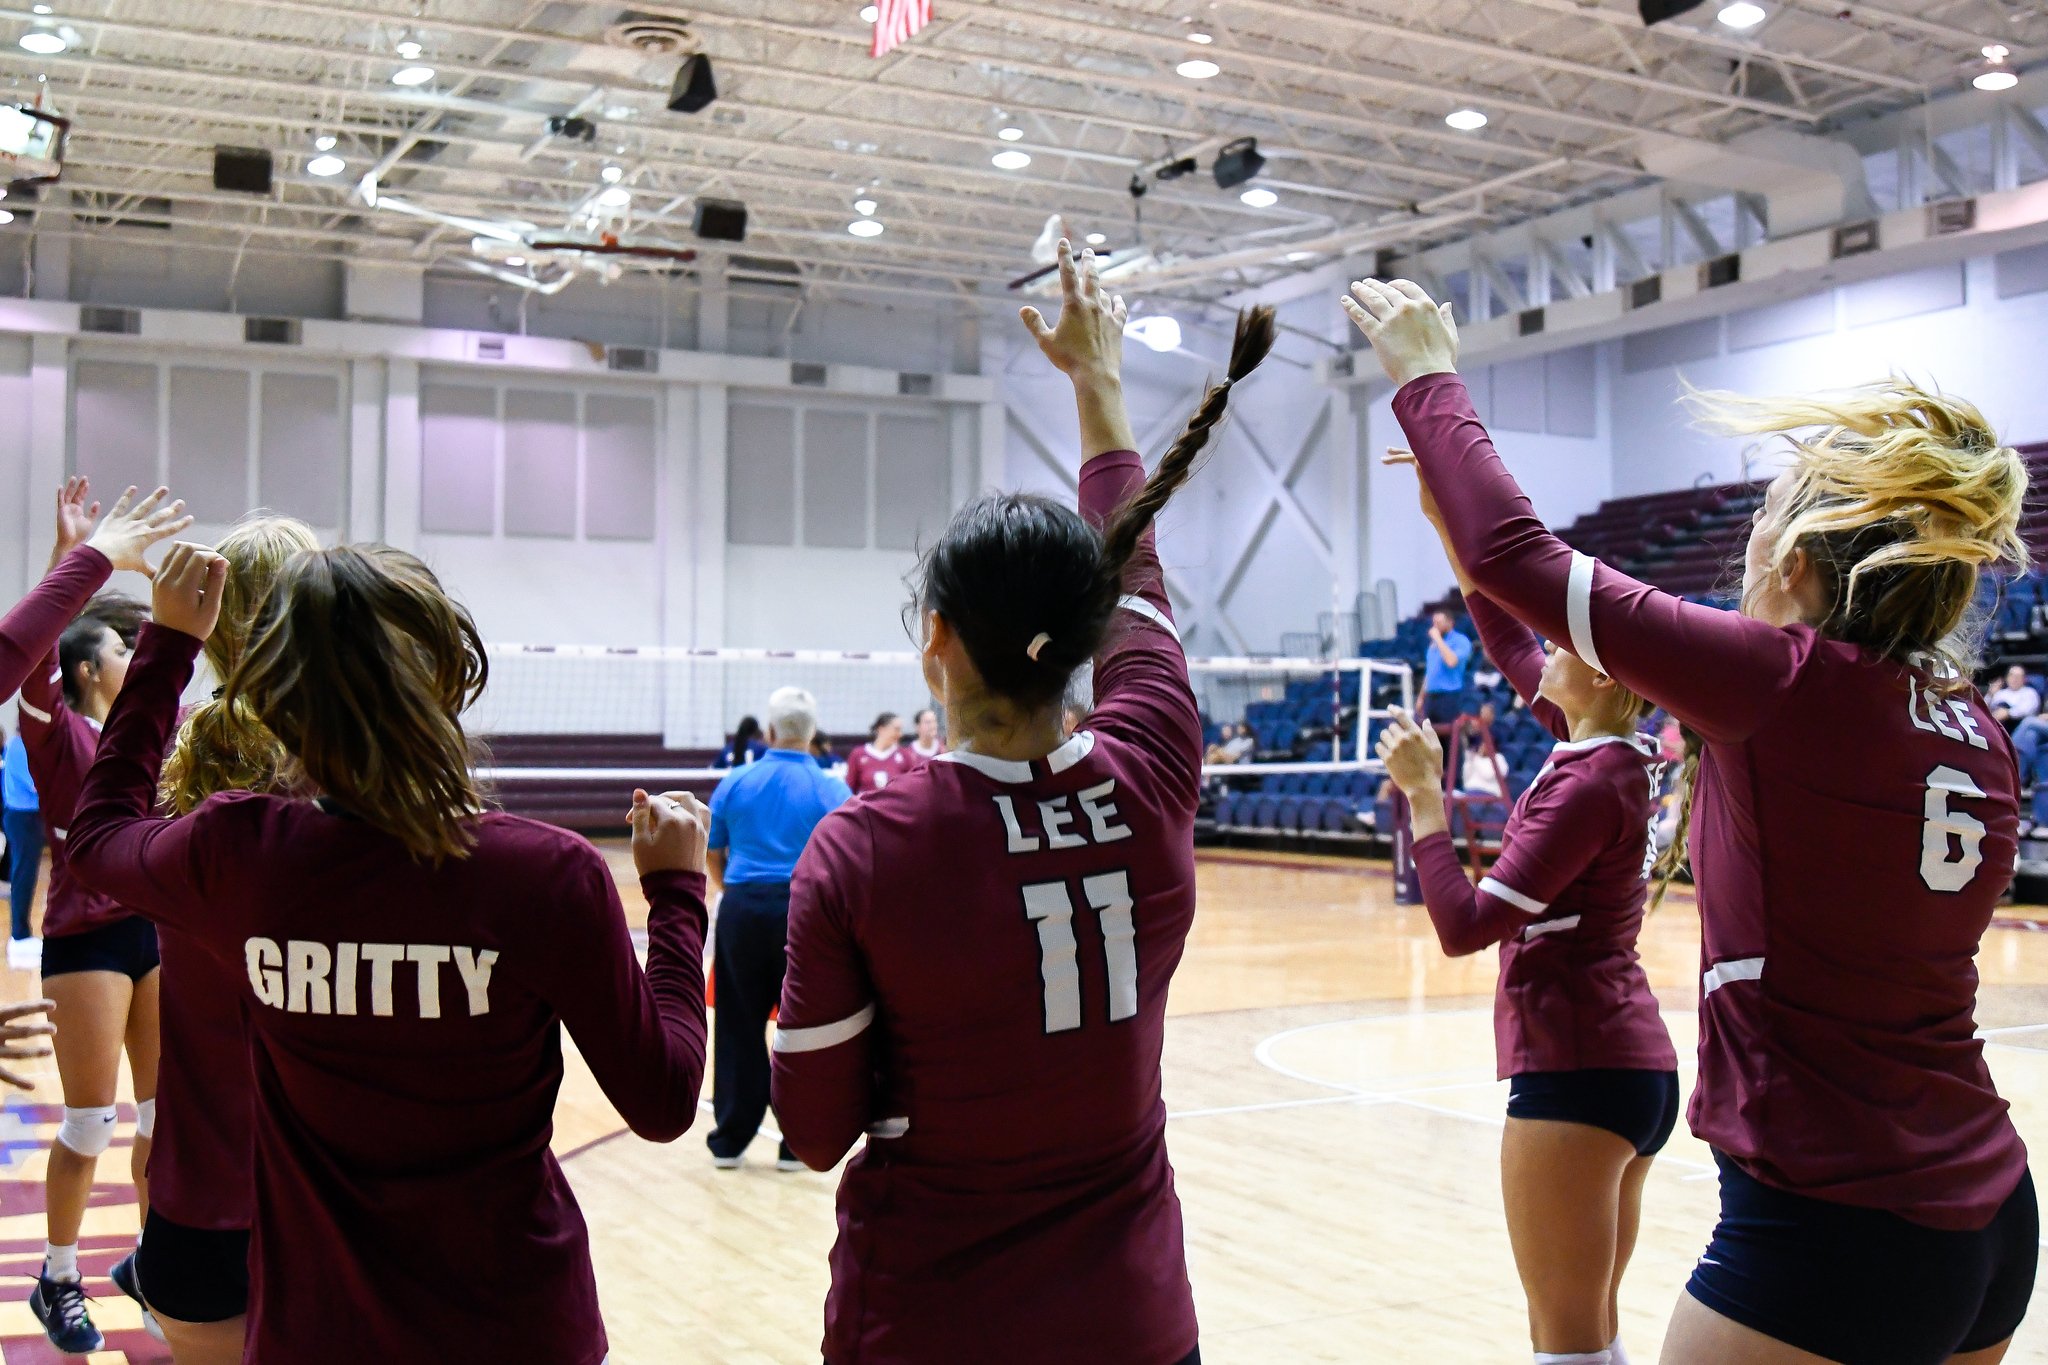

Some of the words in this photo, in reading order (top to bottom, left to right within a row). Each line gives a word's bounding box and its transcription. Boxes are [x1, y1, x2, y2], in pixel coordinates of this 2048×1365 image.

[1908, 674, 1989, 751] LEE
[992, 777, 1133, 853] LEE
[1919, 764, 1988, 892] 6
[245, 936, 500, 1019] GRITTY
[1021, 869, 1139, 1035] 11
